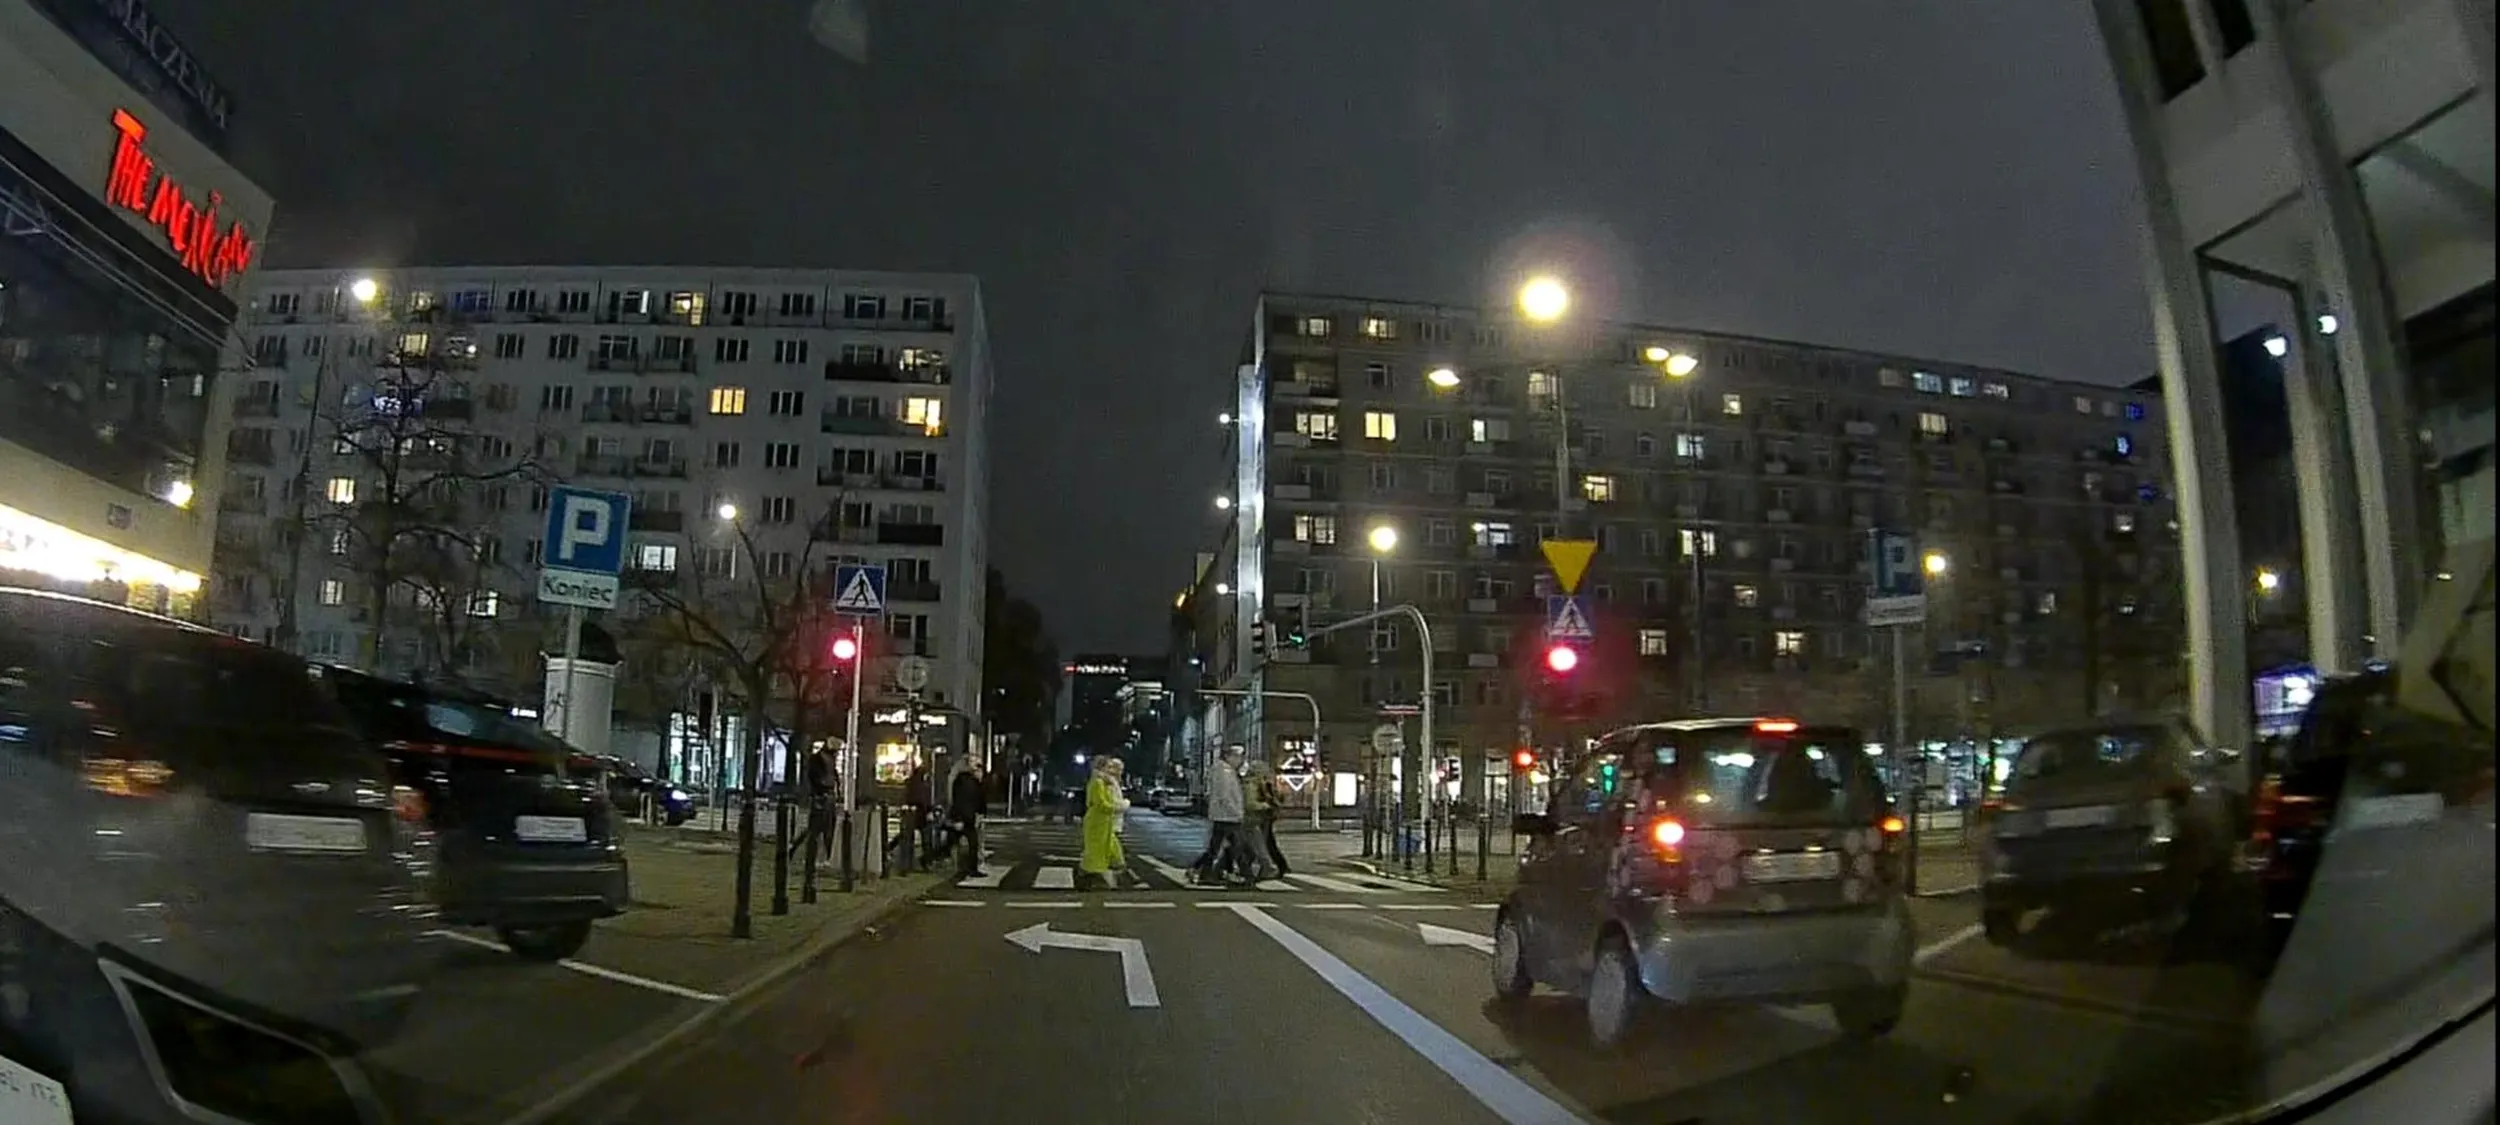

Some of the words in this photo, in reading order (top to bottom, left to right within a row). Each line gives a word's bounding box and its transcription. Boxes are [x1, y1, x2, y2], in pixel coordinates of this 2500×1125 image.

[107, 108, 153, 213] THE
[559, 494, 611, 560] P
[543, 577, 613, 603] Koniec
[1883, 536, 1913, 588] P
